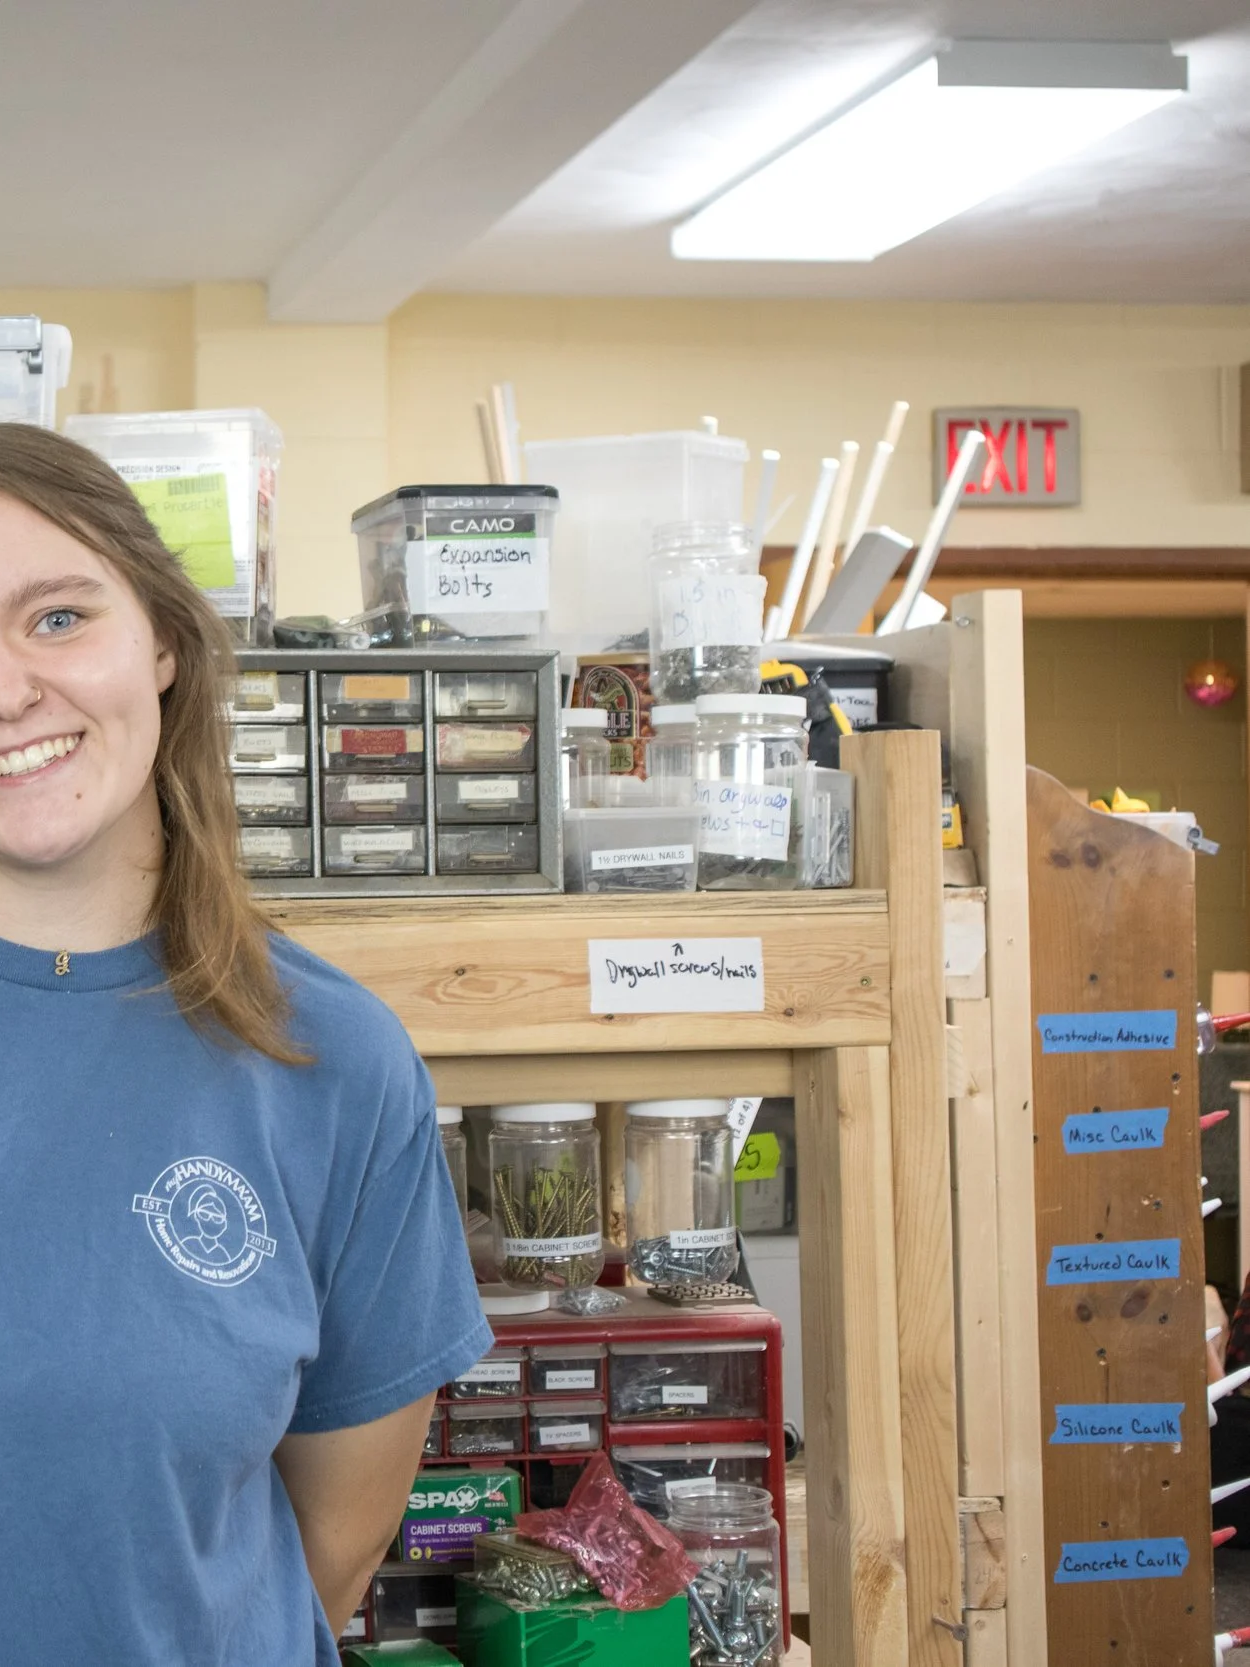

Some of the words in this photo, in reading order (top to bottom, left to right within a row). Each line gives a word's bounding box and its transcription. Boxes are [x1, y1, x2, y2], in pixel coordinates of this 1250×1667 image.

[947, 419, 1069, 494] EXIT
[450, 518, 515, 533] CAMO
[439, 543, 531, 571] Expansion
[438, 573, 493, 598] Bolts
[613, 852, 656, 864] DRYWALL
[659, 850, 685, 861] NAILS
[605, 958, 665, 988] Drywall
[1044, 1028, 1113, 1044] Construction
[1116, 1027, 1170, 1045] Adhesive
[1069, 1128, 1104, 1144] Misc
[1111, 1125, 1157, 1144] Caulk
[141, 1198, 163, 1212] EST.
[155, 1217, 173, 1248] Home
[170, 1245, 201, 1273] Repairs
[202, 1268, 217, 1279] and
[249, 1235, 272, 1251] 2013
[531, 1242, 570, 1252] CABINET
[691, 1233, 725, 1244] CABINET
[1055, 1254, 1122, 1273] Textured
[1127, 1253, 1170, 1270] Caulk
[1061, 1418, 1123, 1437] Silicone
[1131, 1418, 1177, 1436] Caulk
[408, 1490, 476, 1510] SPAX
[410, 1524, 446, 1535] CABINET
[448, 1522, 482, 1533] SCREWS
[1063, 1553, 1129, 1572] Concrete
[1136, 1550, 1182, 1567] Caulk
